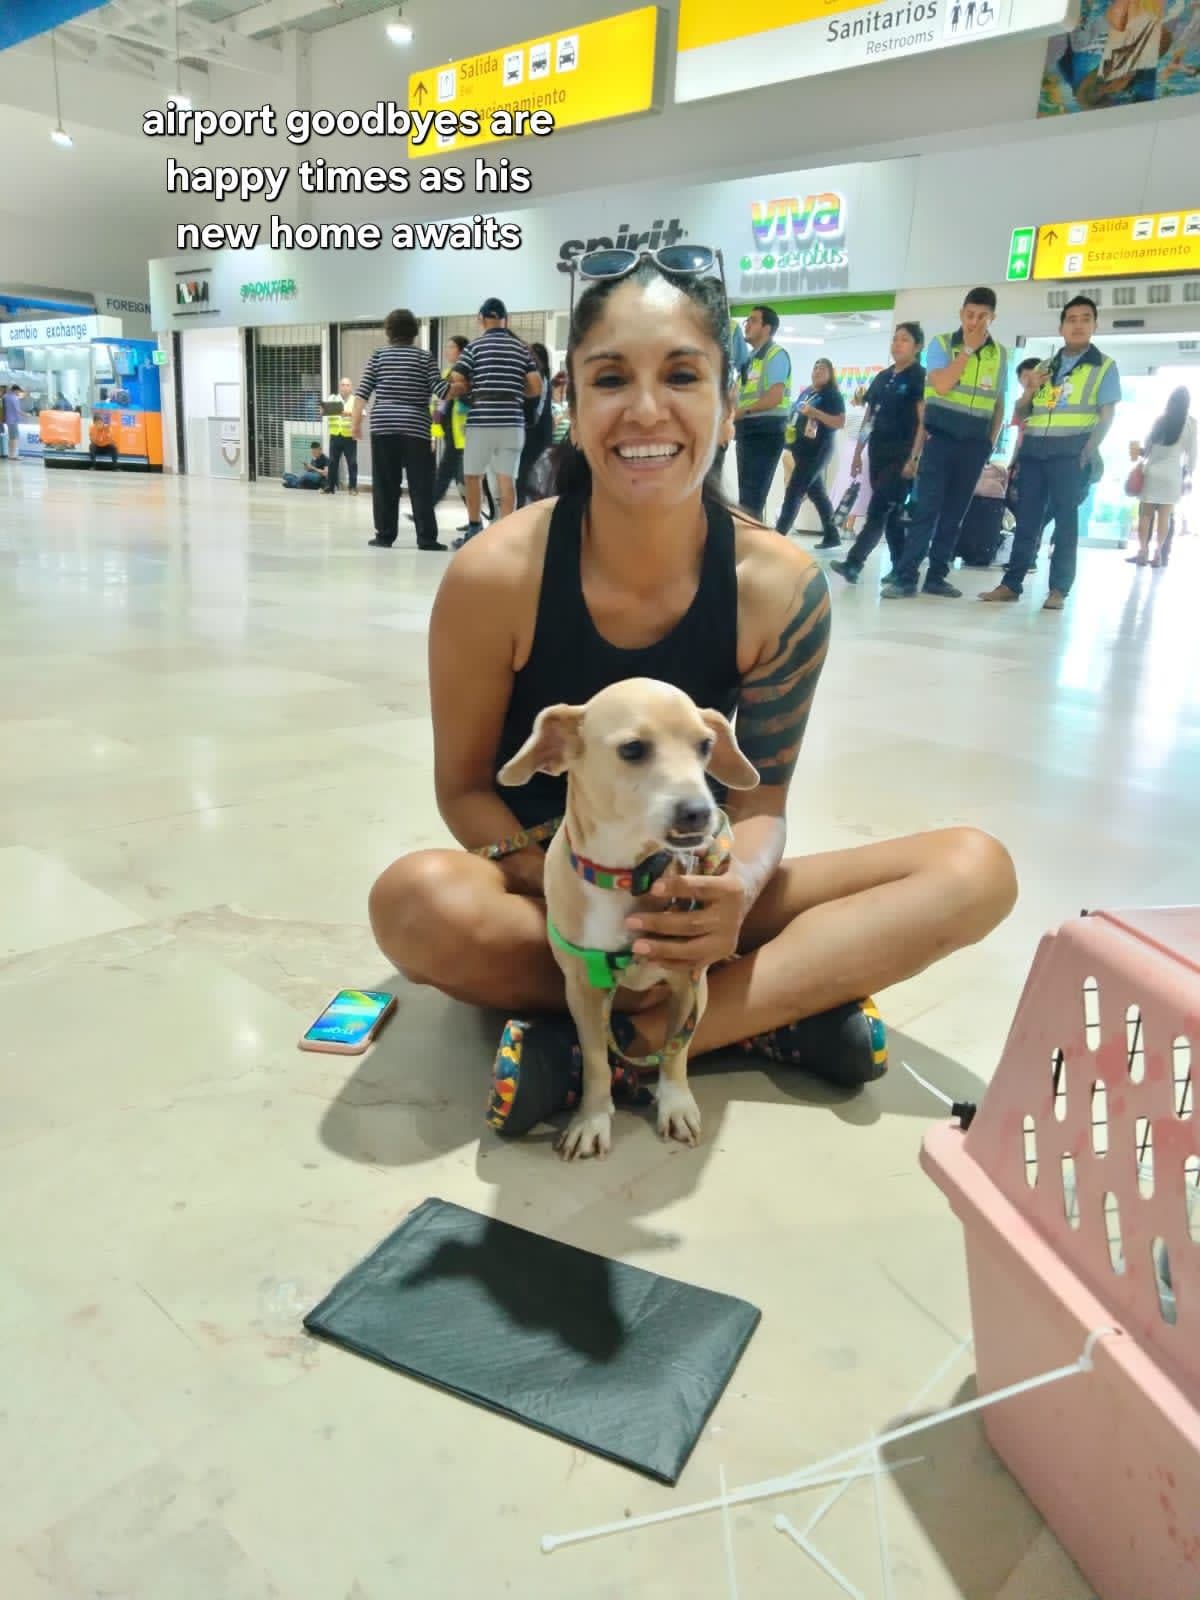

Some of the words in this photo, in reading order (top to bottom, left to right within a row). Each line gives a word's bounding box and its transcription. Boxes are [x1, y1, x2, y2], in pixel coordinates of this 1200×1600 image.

[826, 0, 937, 42] Sanitarios
[866, 30, 934, 55] Restrooms
[460, 56, 498, 80] Salida
[1091, 220, 1129, 233] Salida
[1087, 245, 1191, 262] Estacionamiento
[10, 324, 38, 340] cambio
[46, 321, 87, 340] exchange
